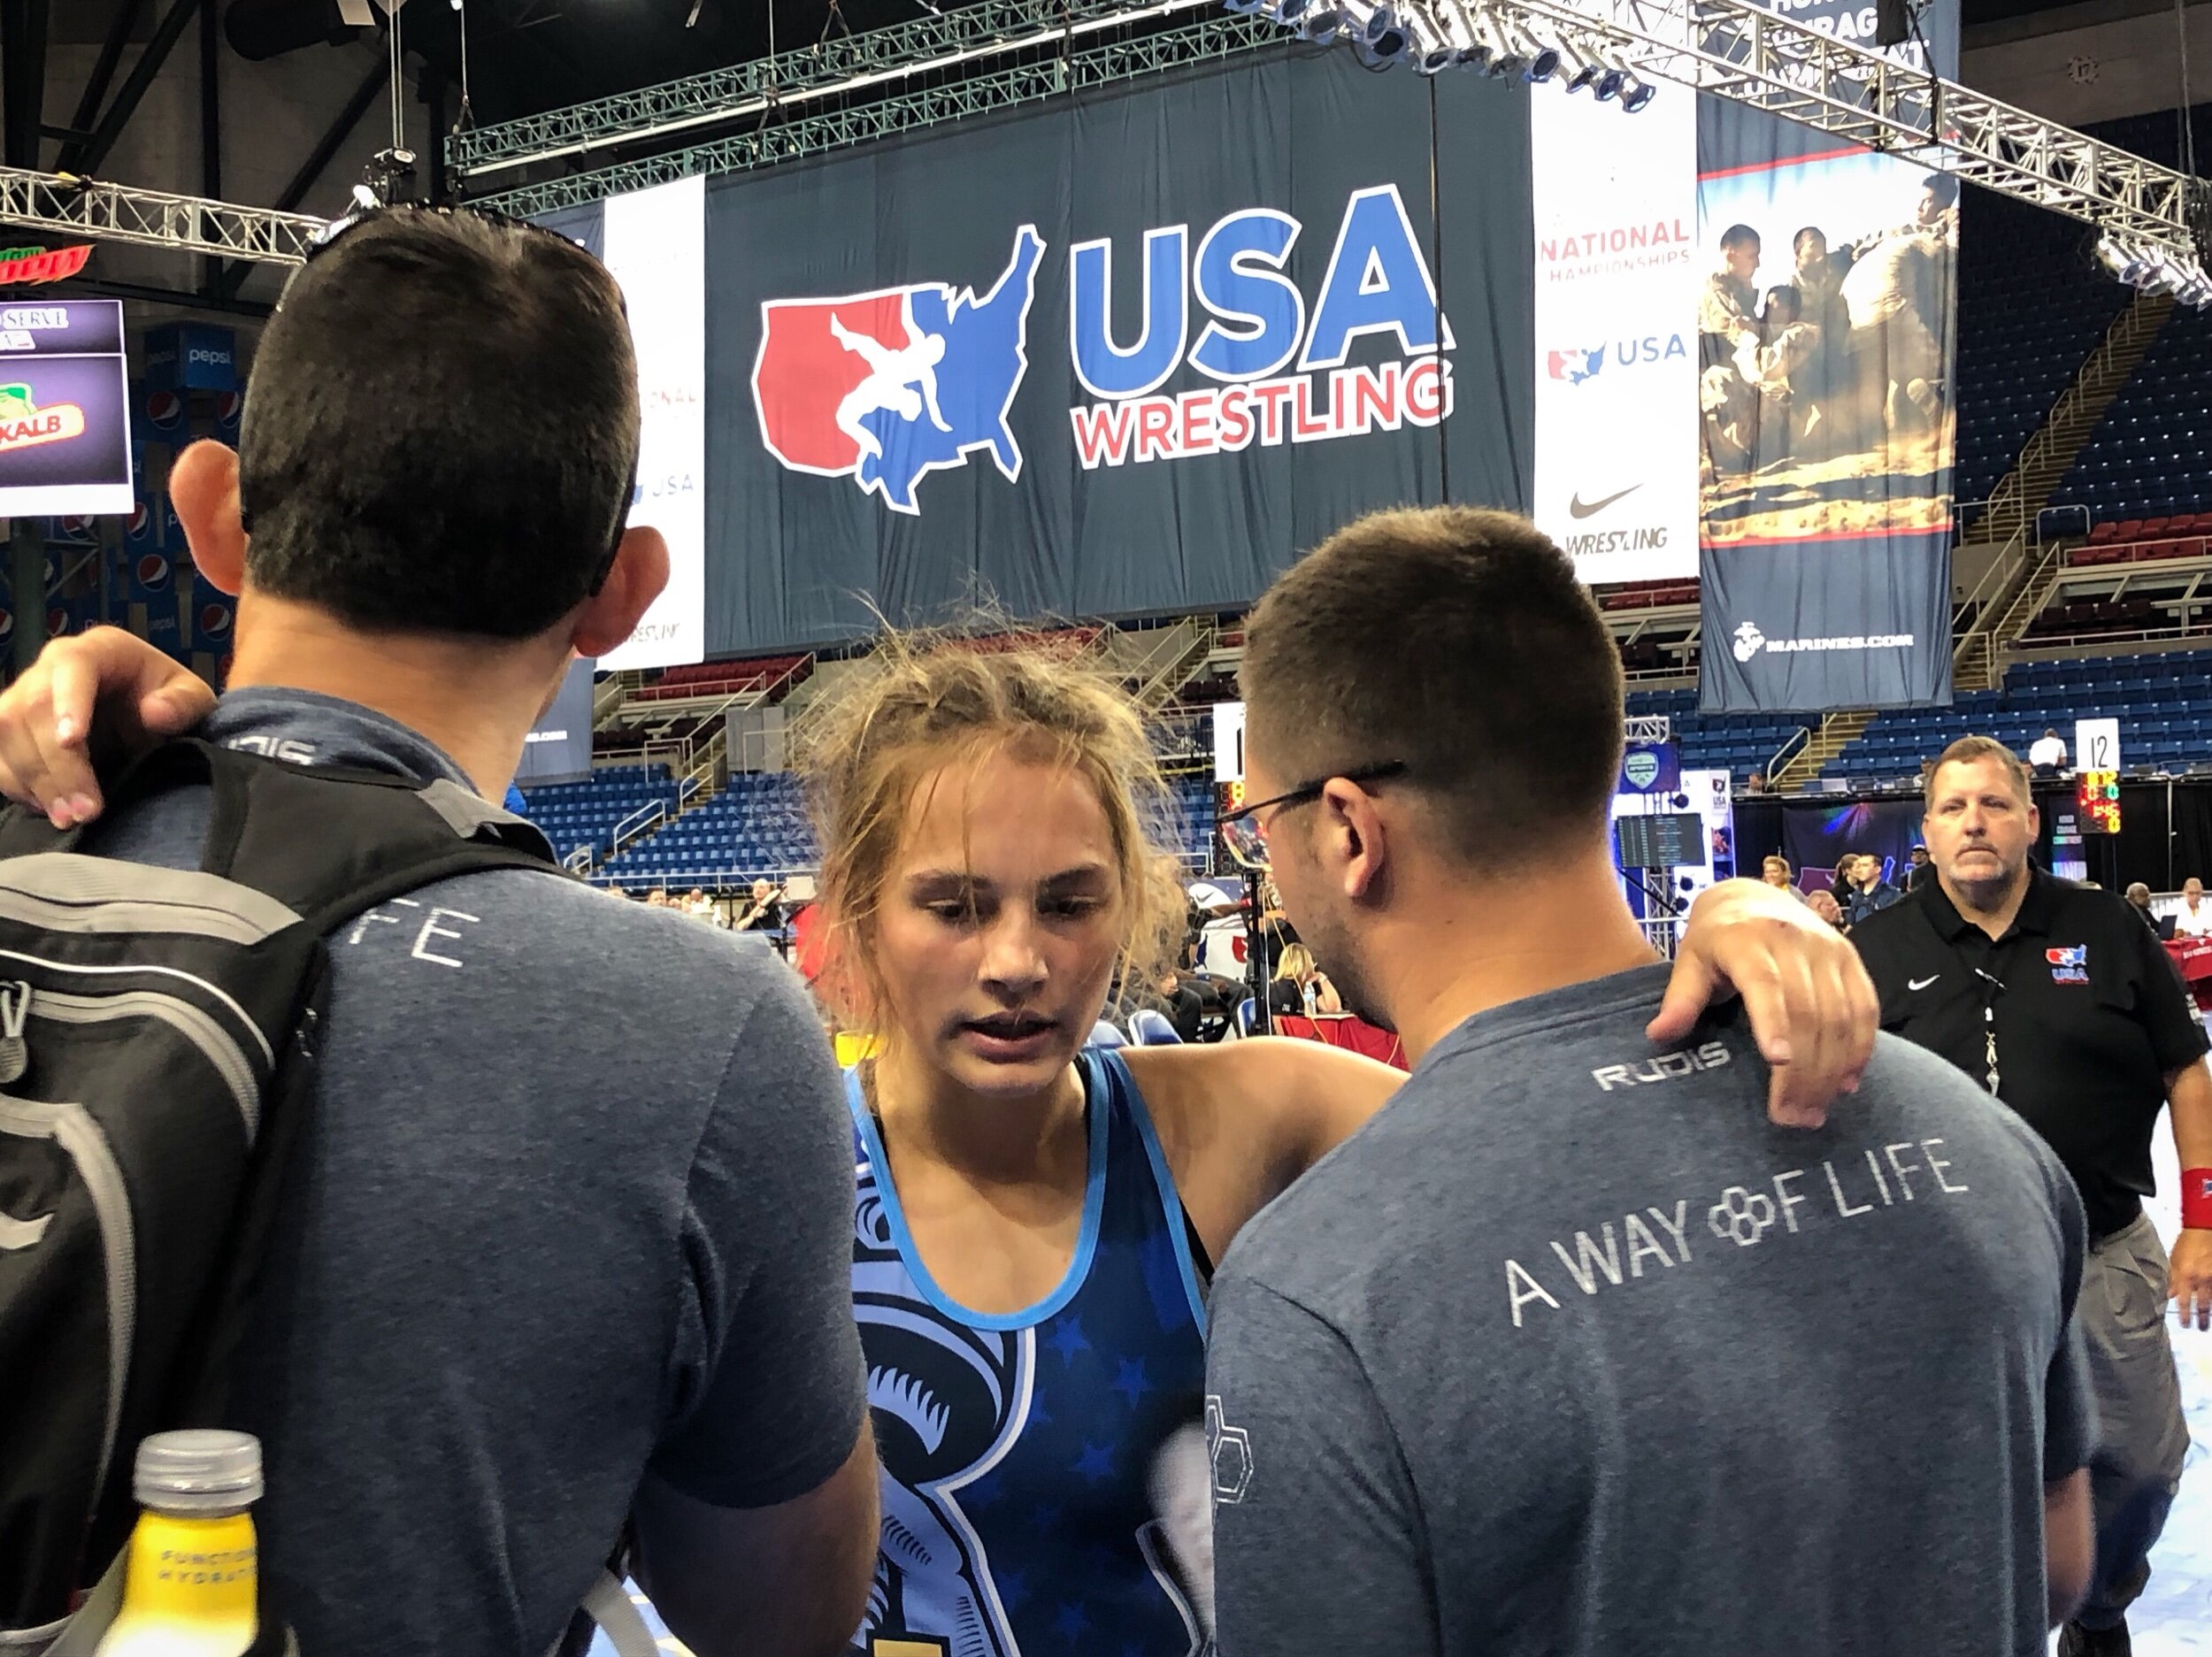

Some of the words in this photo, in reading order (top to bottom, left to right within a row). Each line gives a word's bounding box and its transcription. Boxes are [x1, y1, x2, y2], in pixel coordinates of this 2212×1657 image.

[1540, 219, 1689, 261] NATIONAL
[1549, 249, 1690, 282] HAMPIONSHIPS
[1070, 183, 1456, 400] USA
[188, 348, 232, 365] pepsi
[1617, 334, 1686, 366] USA
[0, 415, 61, 442] KALB
[1070, 356, 1454, 470] WRESTLING
[1565, 526, 1668, 556] WRESTLING
[1766, 634, 1914, 653] MARINES.COM
[2091, 735, 2108, 769] 12
[1713, 796, 1727, 806] USA
[2051, 967, 2089, 981] USA
[1592, 1040, 1732, 1092] RUDIS
[1505, 1259, 1560, 1327] A
[1550, 1199, 1692, 1294] WAY
[1823, 1138, 1970, 1218] LIFE
